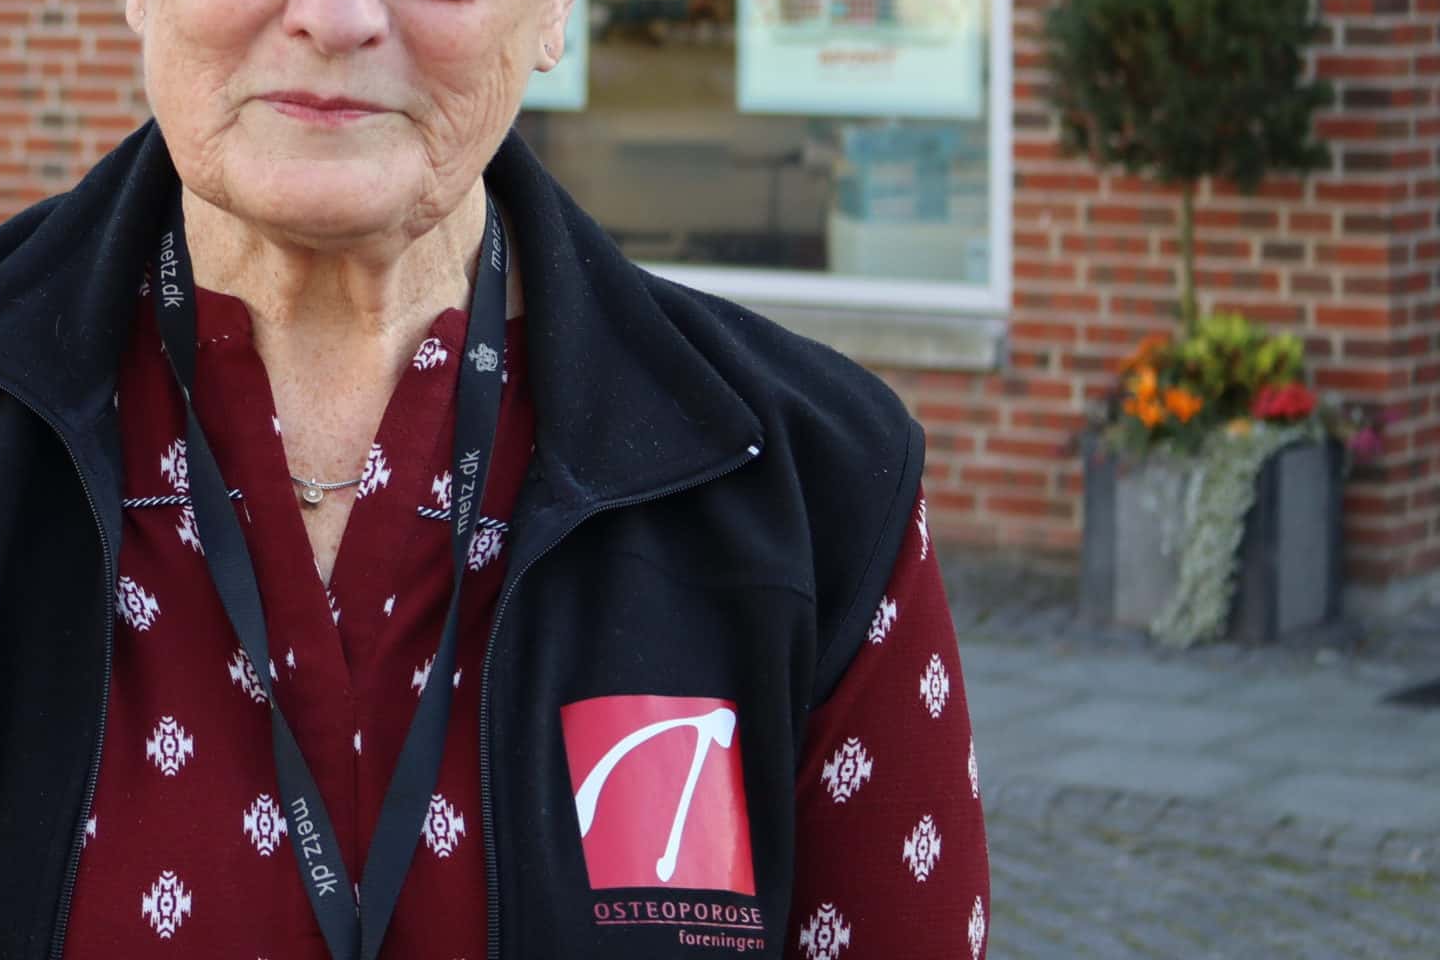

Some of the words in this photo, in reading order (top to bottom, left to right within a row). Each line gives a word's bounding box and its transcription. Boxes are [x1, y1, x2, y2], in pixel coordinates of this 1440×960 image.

[160, 231, 185, 308] metz.dk
[457, 449, 481, 535] metz.dk
[291, 797, 338, 896] metz.dk
[594, 901, 763, 924] OSTEOPOROSE
[678, 929, 765, 952] foreningen
